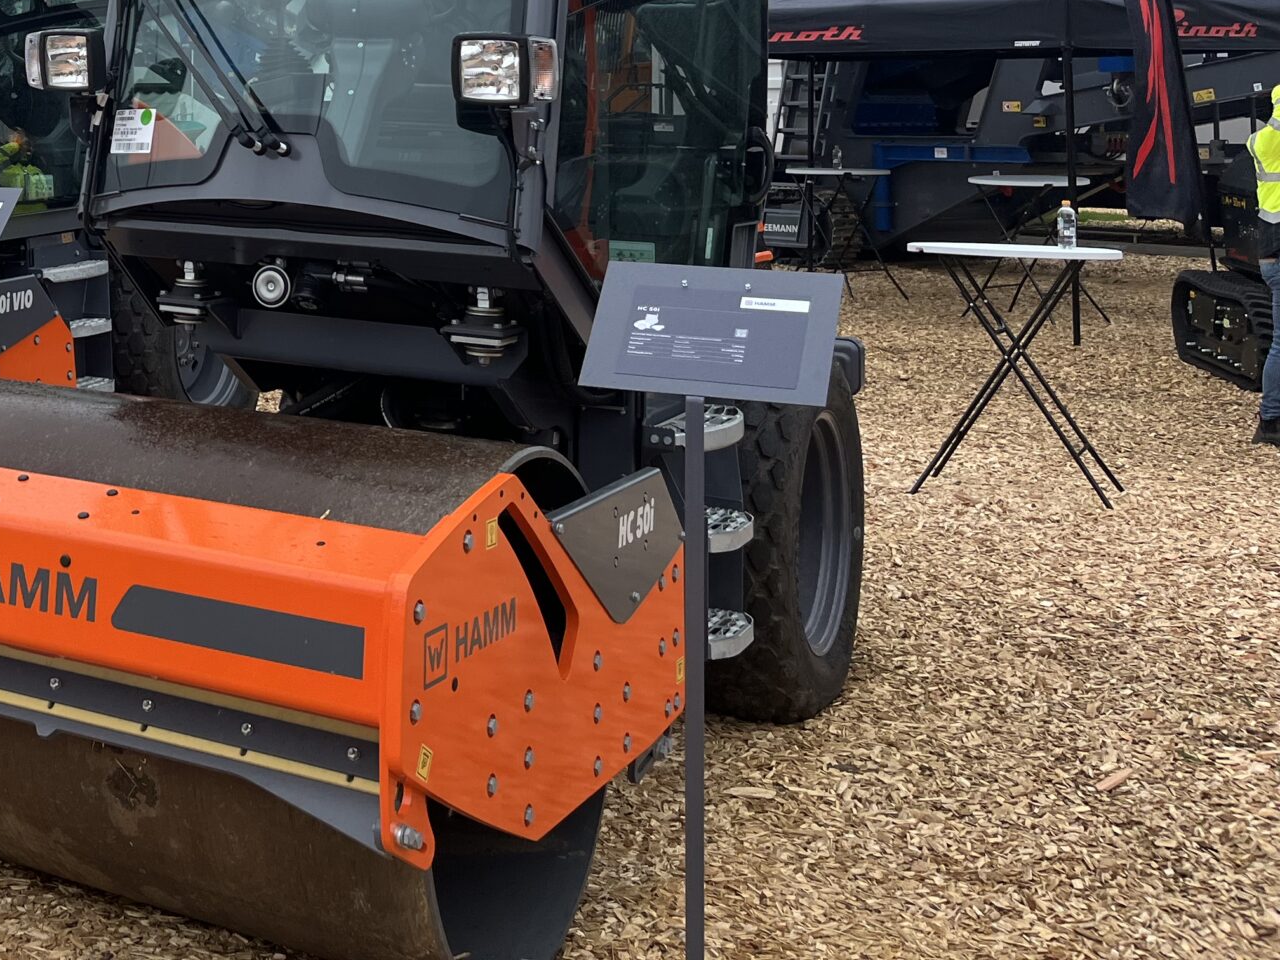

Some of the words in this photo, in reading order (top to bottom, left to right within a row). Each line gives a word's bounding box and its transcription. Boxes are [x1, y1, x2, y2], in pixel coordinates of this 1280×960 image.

[768, 25, 863, 43] noth
[764, 223, 798, 233] EEMANN
[12, 289, 33, 310] VIO
[618, 514, 635, 549] HC
[636, 499, 655, 539] 50i
[454, 597, 516, 664] HAMM
